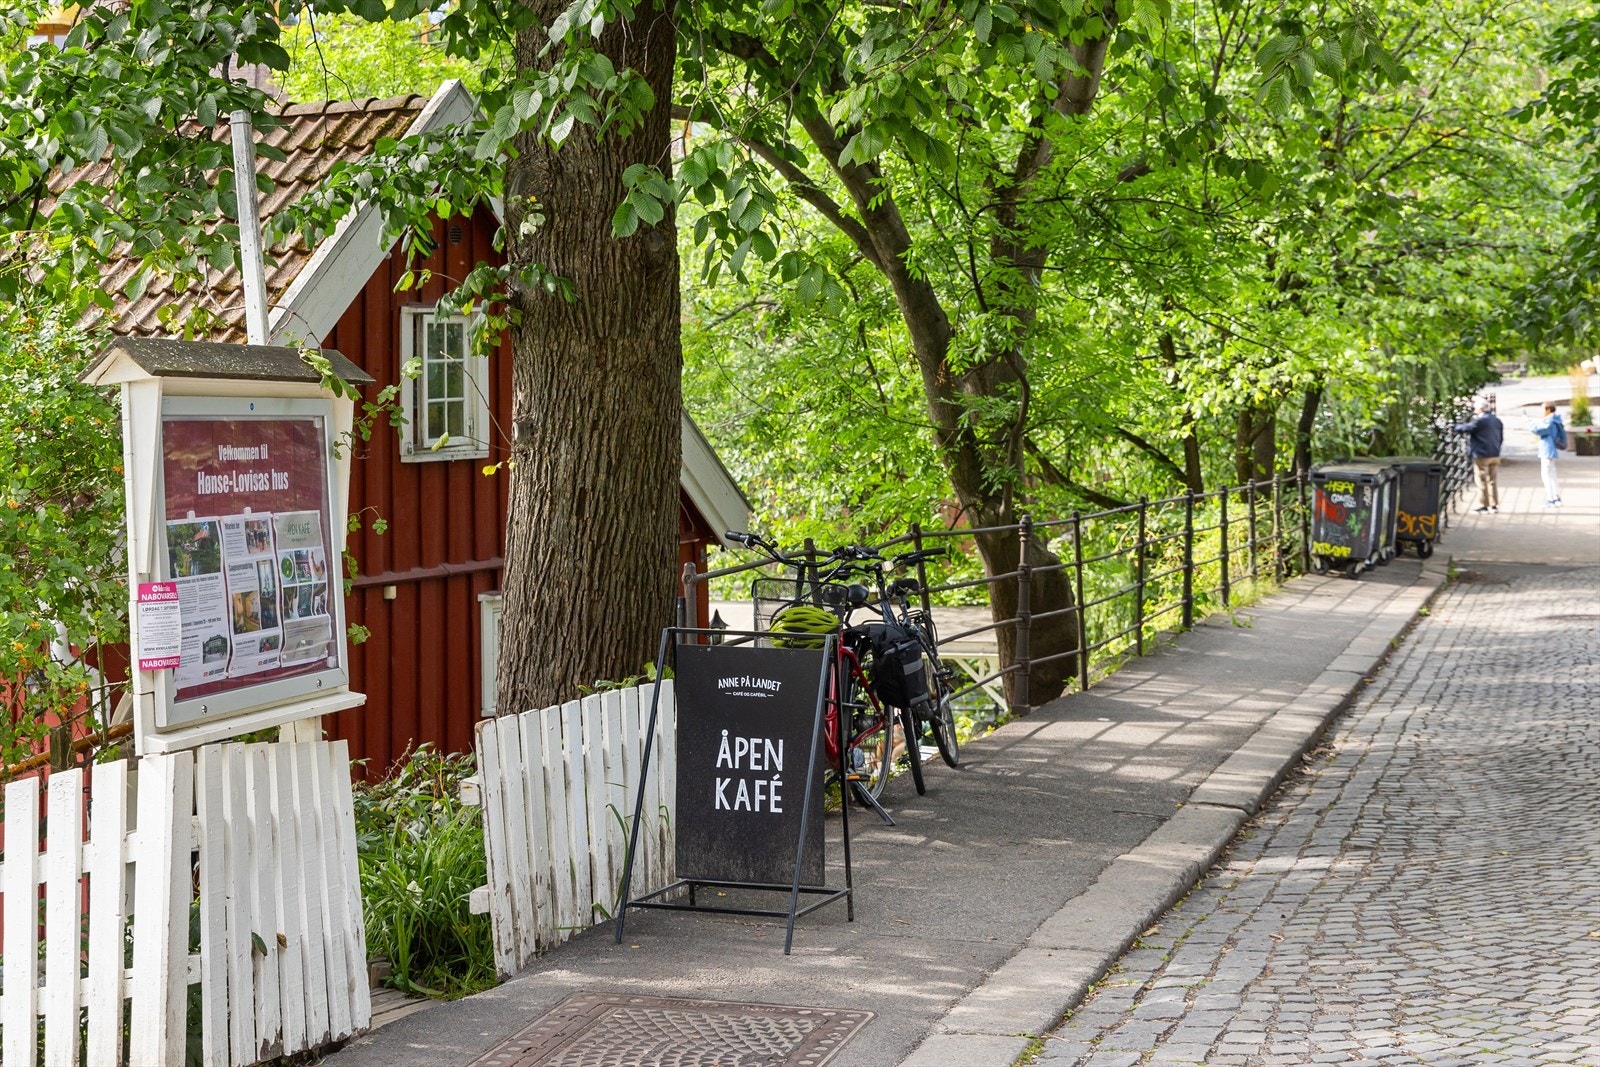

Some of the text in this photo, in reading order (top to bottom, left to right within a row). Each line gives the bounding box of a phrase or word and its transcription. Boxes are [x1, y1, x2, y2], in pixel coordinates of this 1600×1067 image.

[218, 443, 268, 461] Velkommen til
[198, 468, 289, 494] Hønse-Lovisas hus
[718, 675, 782, 692] ANNE PÅ LANDET
[716, 729, 783, 771] ÅPEN
[715, 773, 783, 813] KAFÉ
